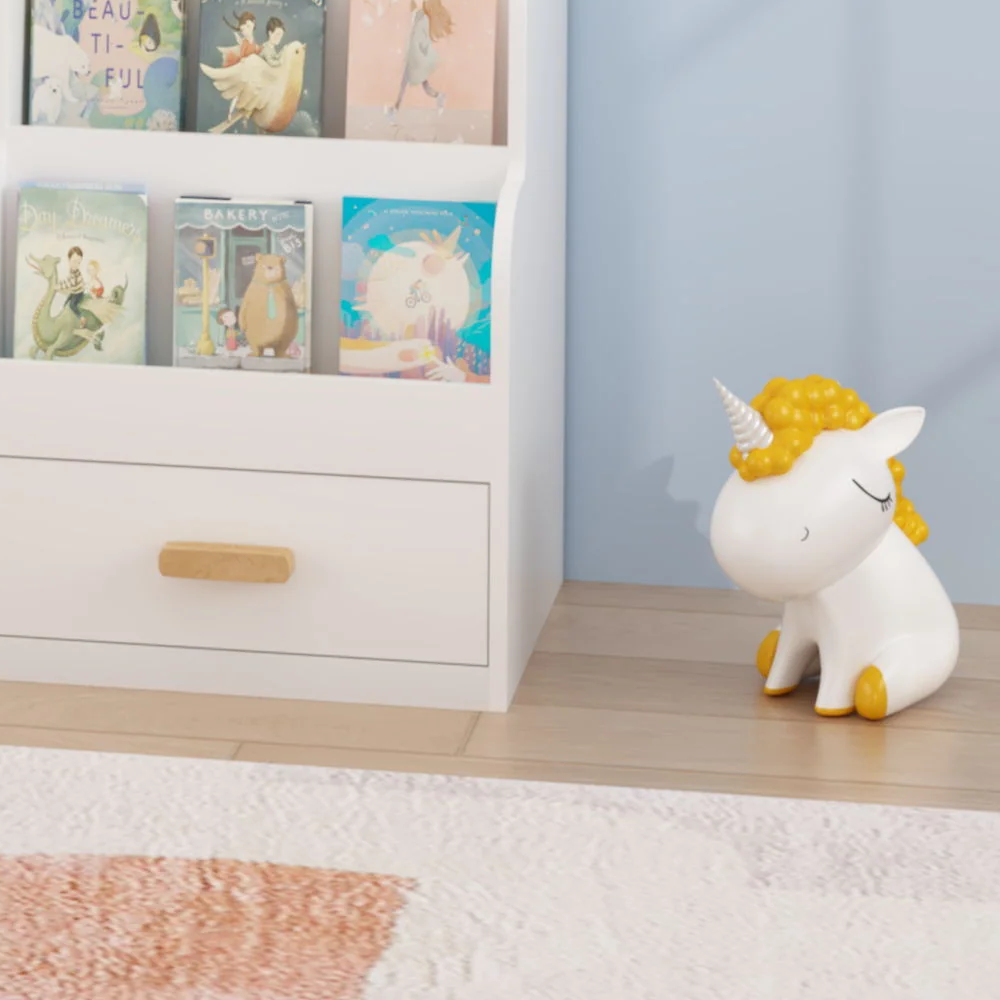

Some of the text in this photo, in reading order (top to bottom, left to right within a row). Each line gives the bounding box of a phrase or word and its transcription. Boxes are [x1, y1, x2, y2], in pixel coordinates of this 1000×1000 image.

[72, 0, 145, 20] BEAU-
[91, 32, 124, 54] TI-
[105, 67, 144, 89] FUL
[203, 208, 268, 221] BAKERY
